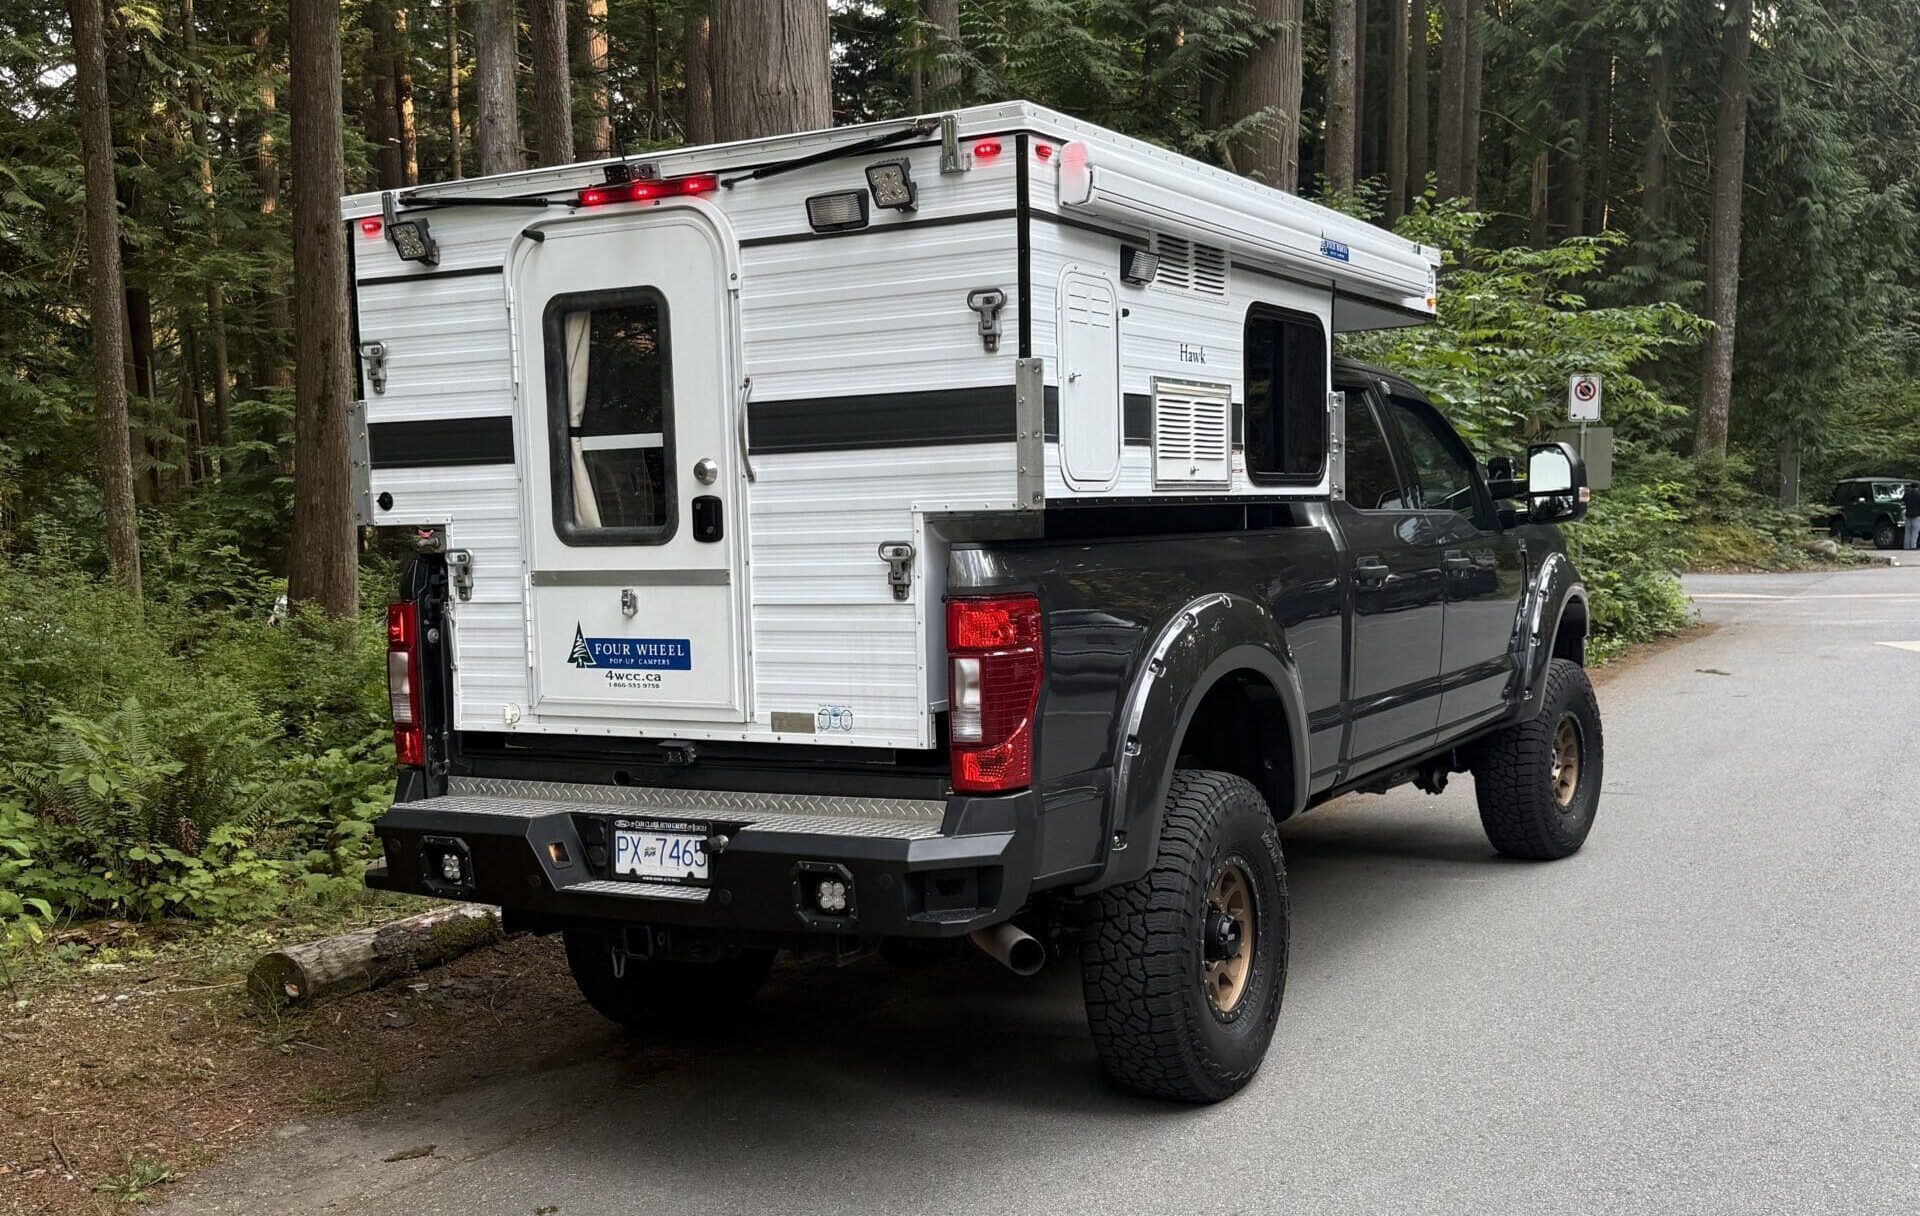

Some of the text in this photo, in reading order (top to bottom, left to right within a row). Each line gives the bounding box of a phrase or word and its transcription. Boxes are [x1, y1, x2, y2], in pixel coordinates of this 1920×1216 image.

[1180, 343, 1206, 364] Hawk
[595, 643, 685, 656] FOUR WHEEL
[605, 670, 662, 682] 4wcc.ca
[616, 836, 707, 868] PX 7465
